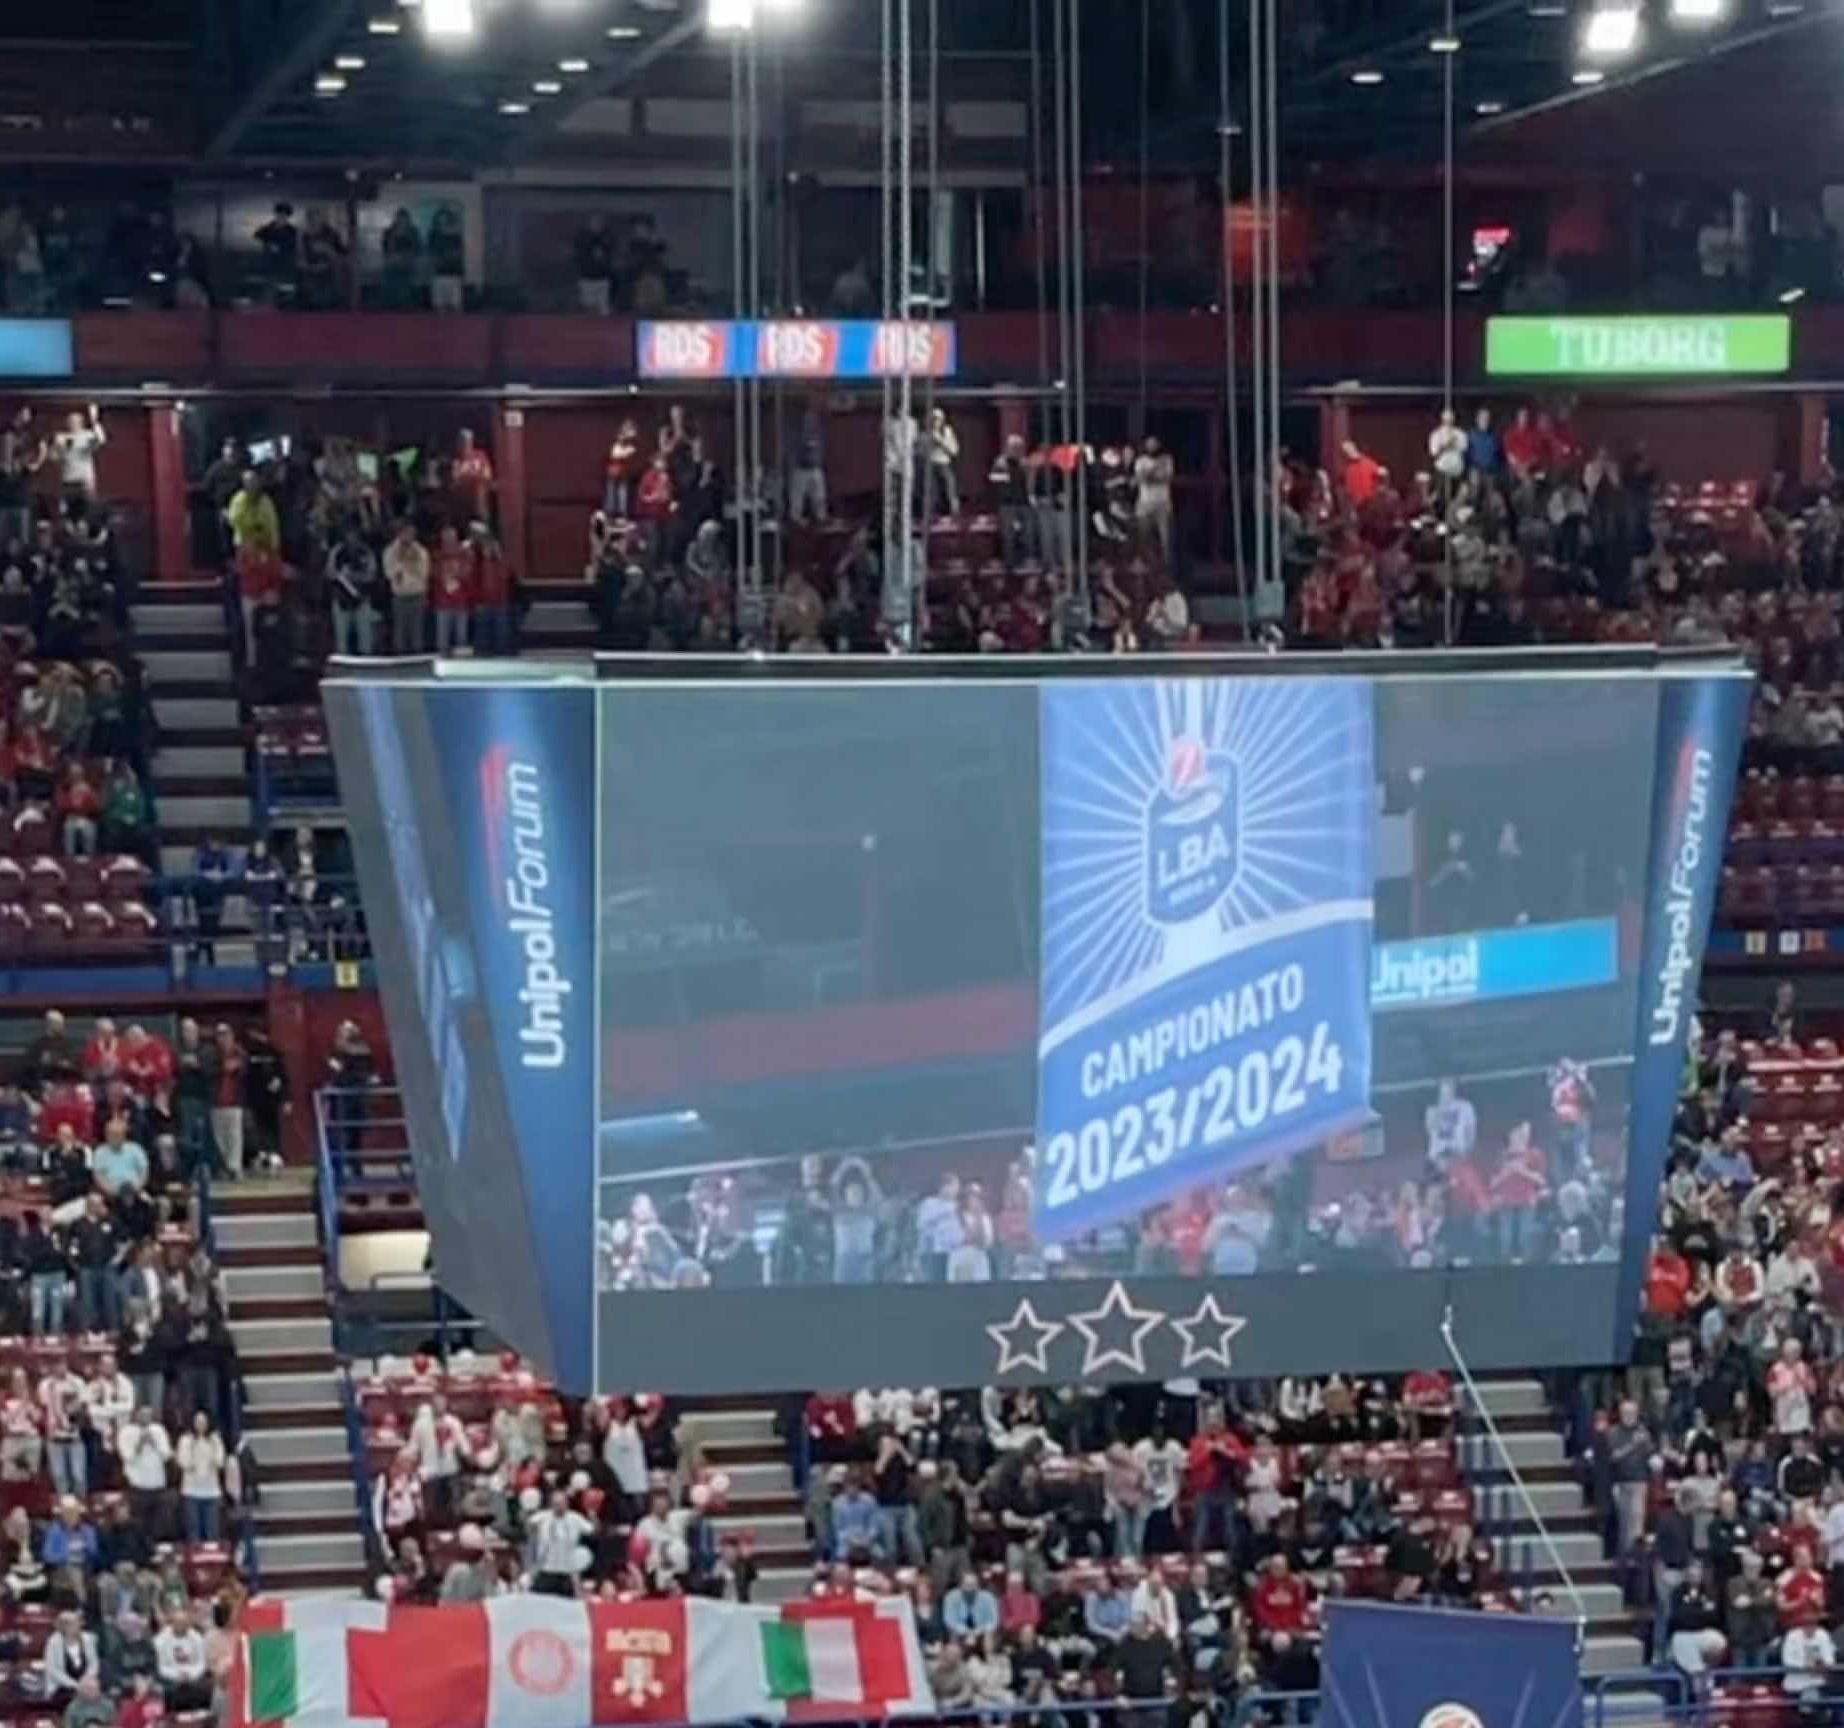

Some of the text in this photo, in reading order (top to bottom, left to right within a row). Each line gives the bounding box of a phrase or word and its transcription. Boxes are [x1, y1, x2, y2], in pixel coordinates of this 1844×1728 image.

[654, 324, 713, 367] RDS
[1550, 322, 1727, 368] TUBORG
[1159, 822, 1231, 886] LBA
[1080, 962, 1306, 1098] CAMPIONATO
[1045, 1020, 1344, 1208] 2023/2024
